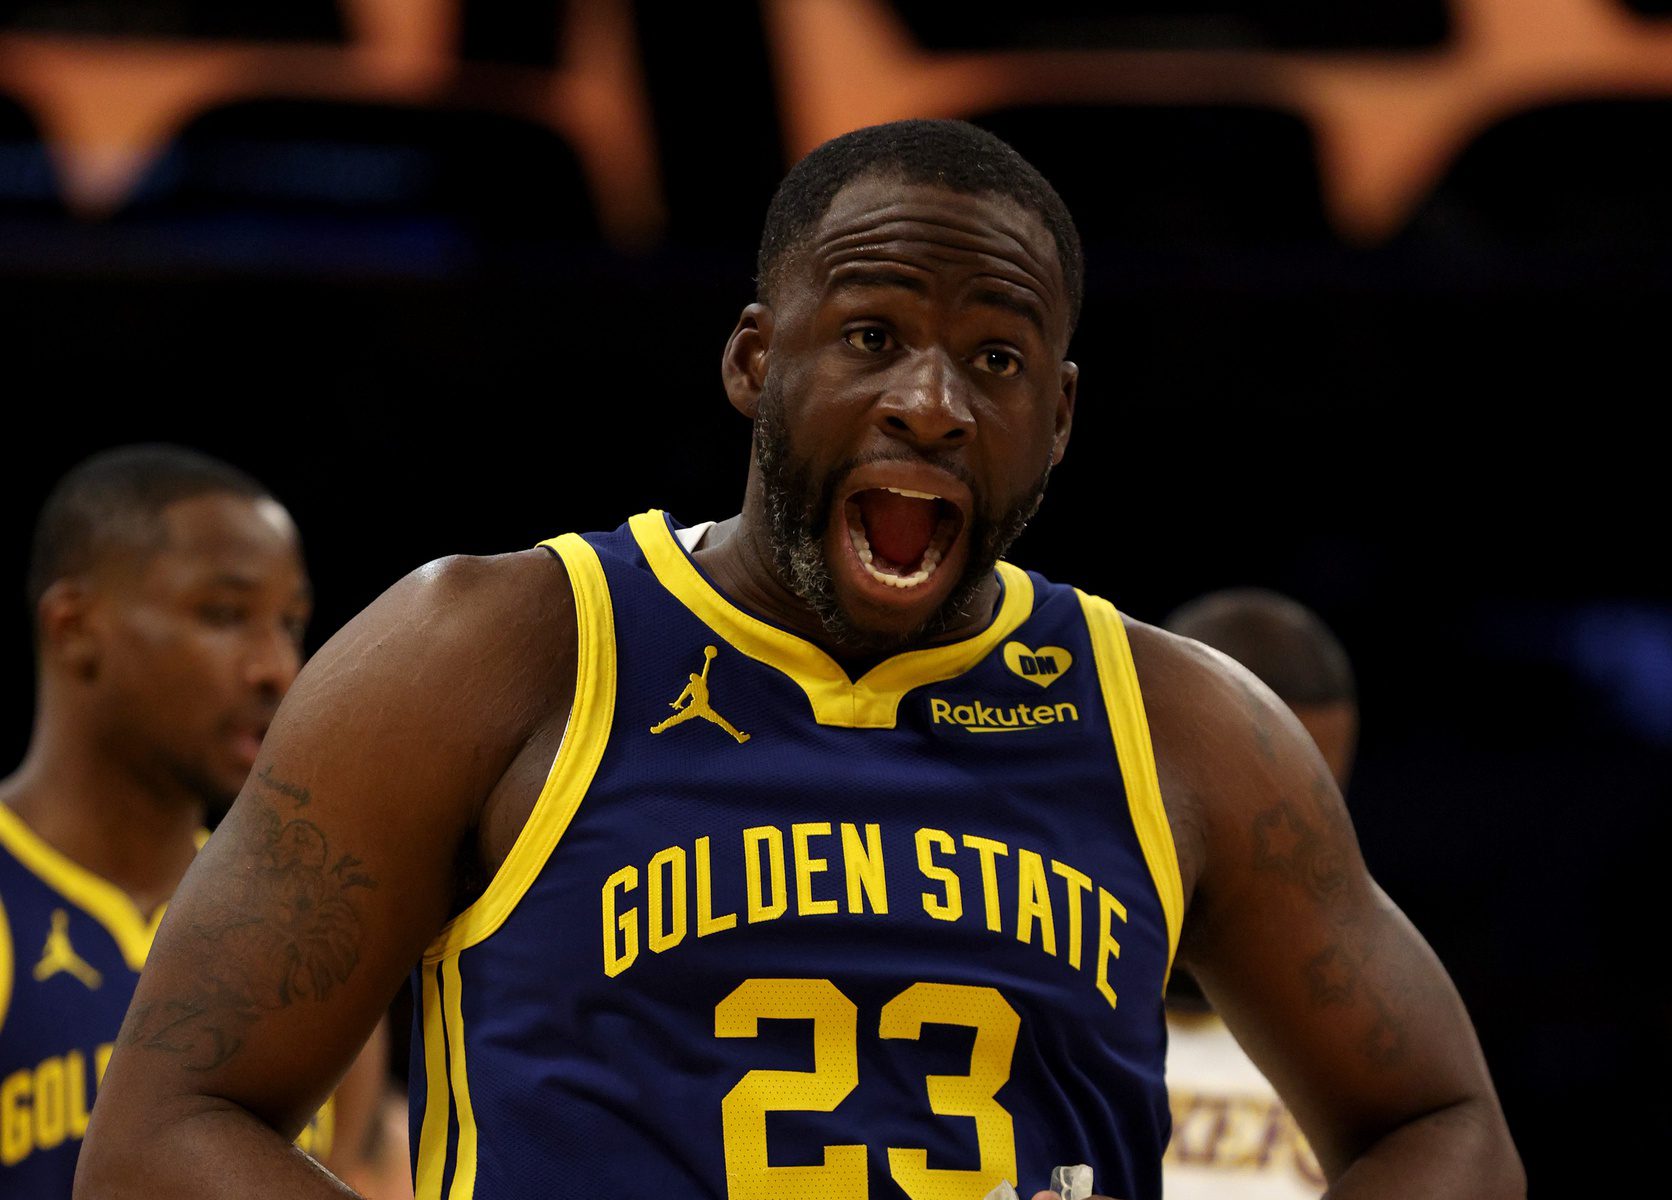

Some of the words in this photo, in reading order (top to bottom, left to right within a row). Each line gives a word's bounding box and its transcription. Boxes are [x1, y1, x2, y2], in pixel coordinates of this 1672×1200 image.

[1019, 655, 1059, 675] DM
[930, 698, 1079, 726] Rakuten
[601, 822, 888, 979] GOLDEN
[914, 827, 1128, 1009] STATE
[0, 1042, 114, 1166] GOL
